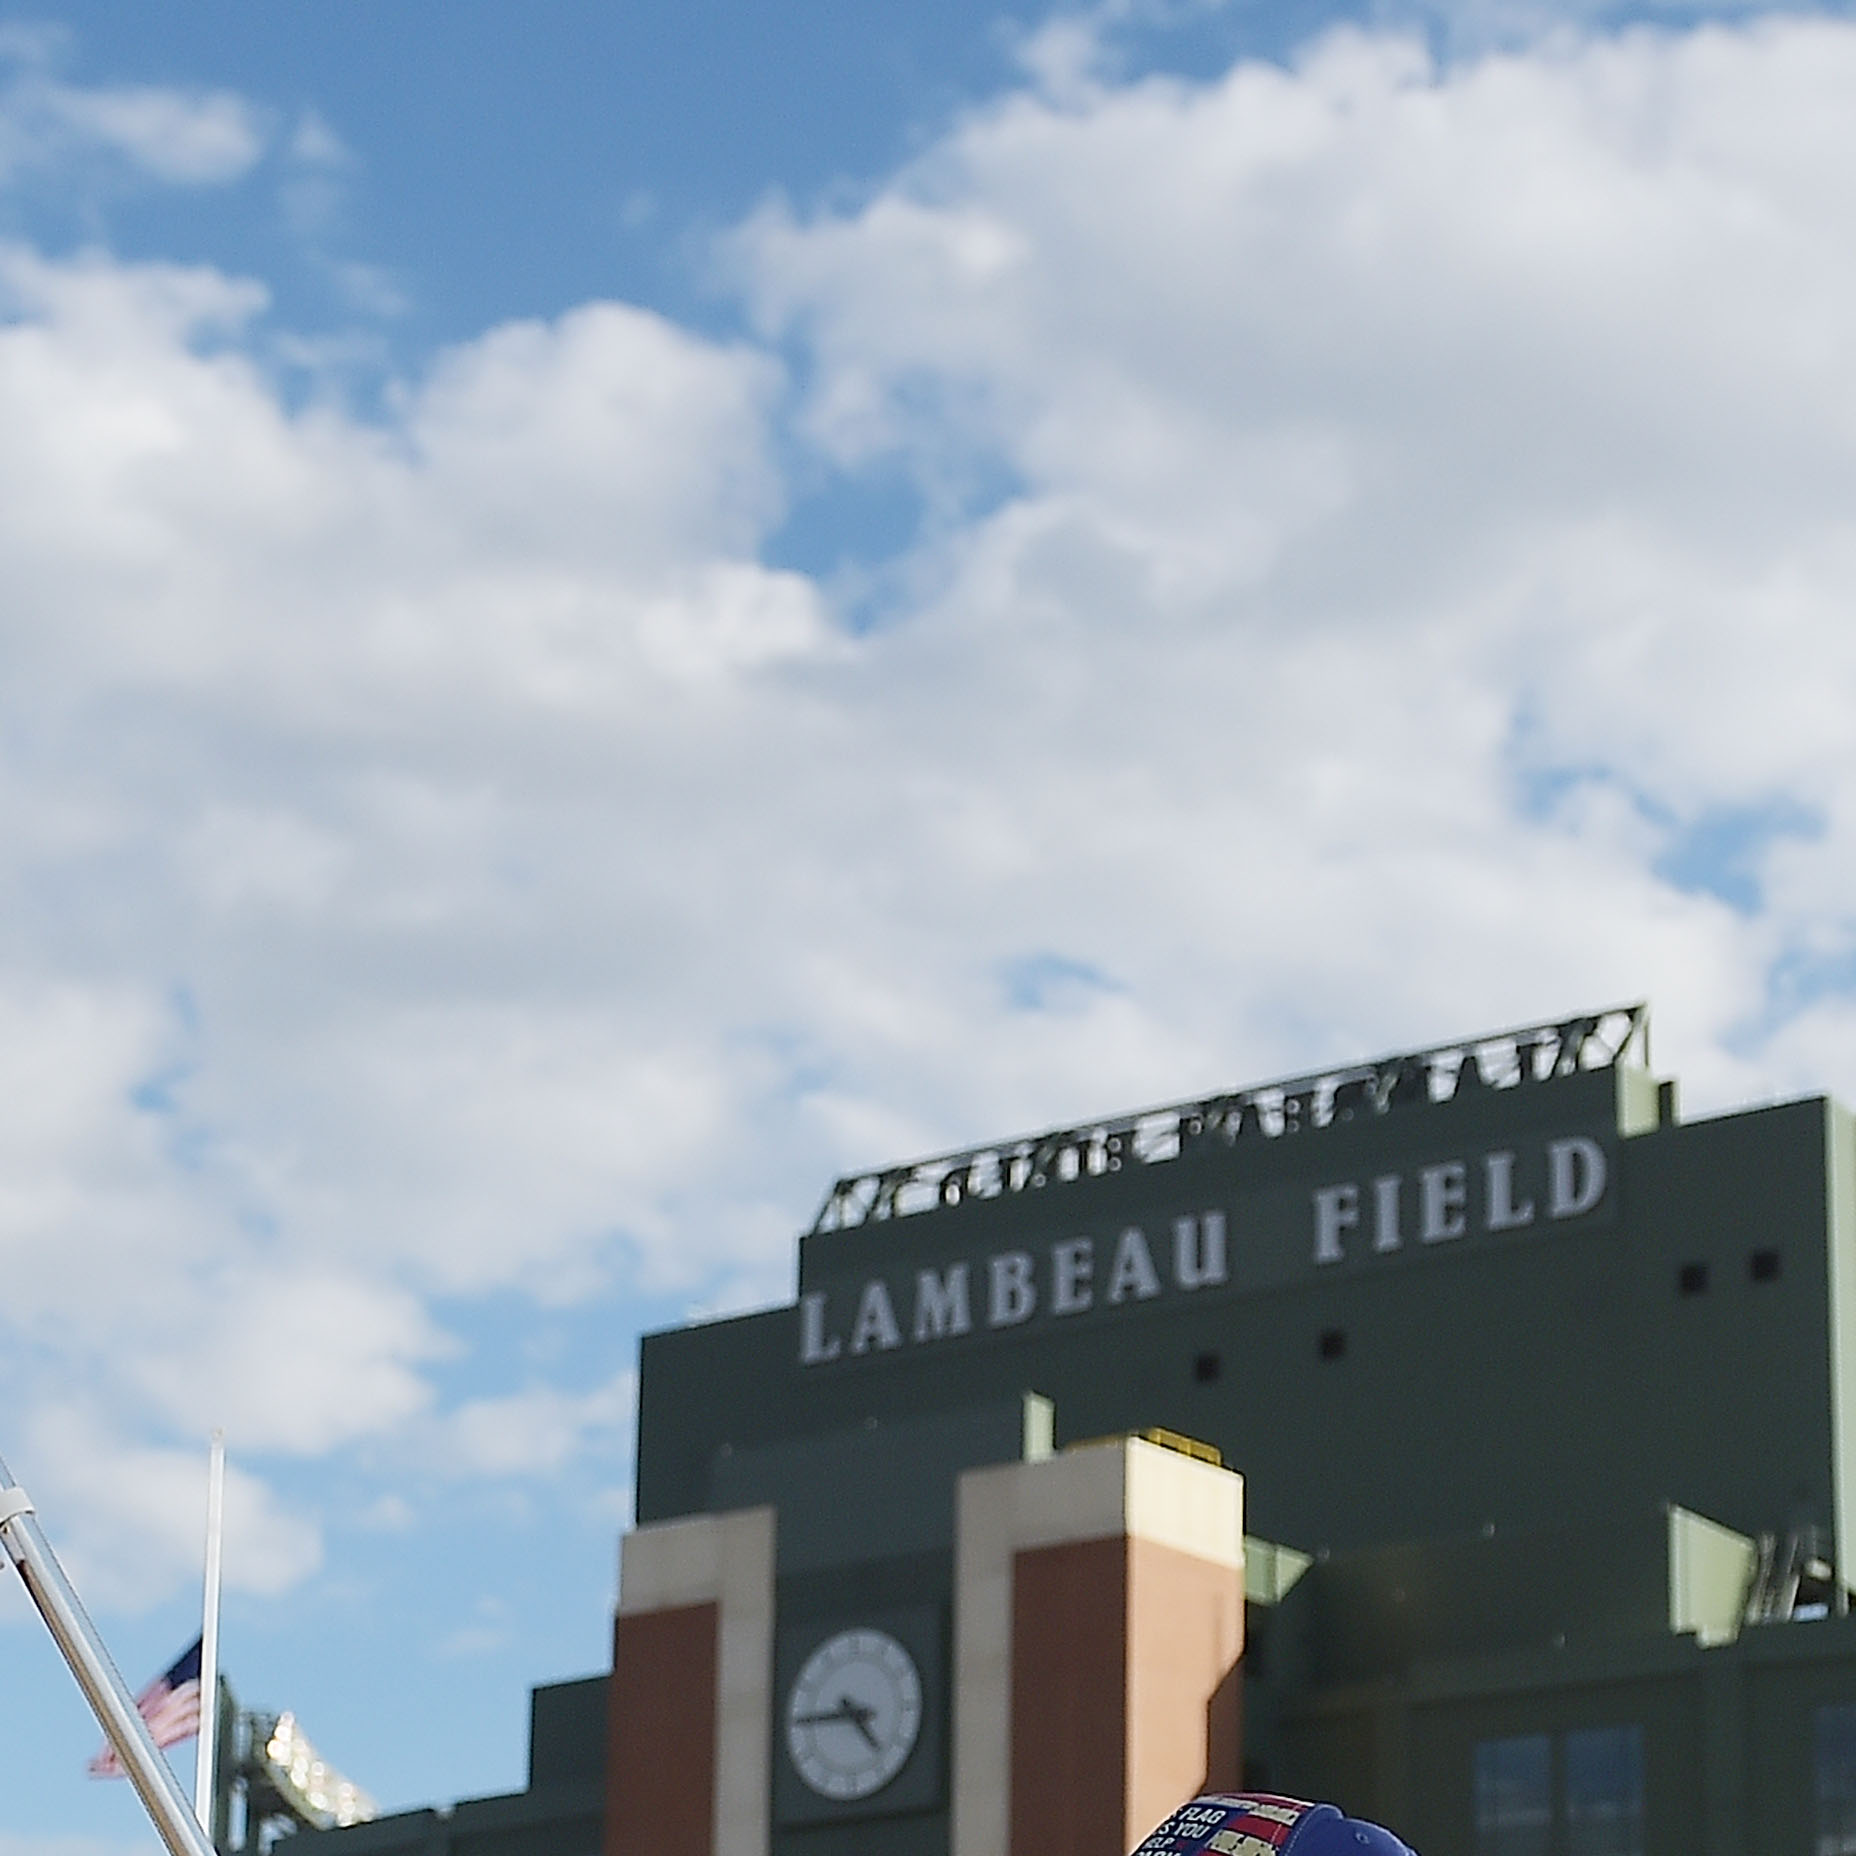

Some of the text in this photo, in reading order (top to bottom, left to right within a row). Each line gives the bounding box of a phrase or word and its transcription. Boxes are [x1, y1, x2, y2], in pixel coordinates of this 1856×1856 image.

[797, 1135, 1612, 1365] LAMBEAU FIELD
[1178, 1806, 1227, 1825] FLAG
[1173, 1822, 1211, 1839] YOU
